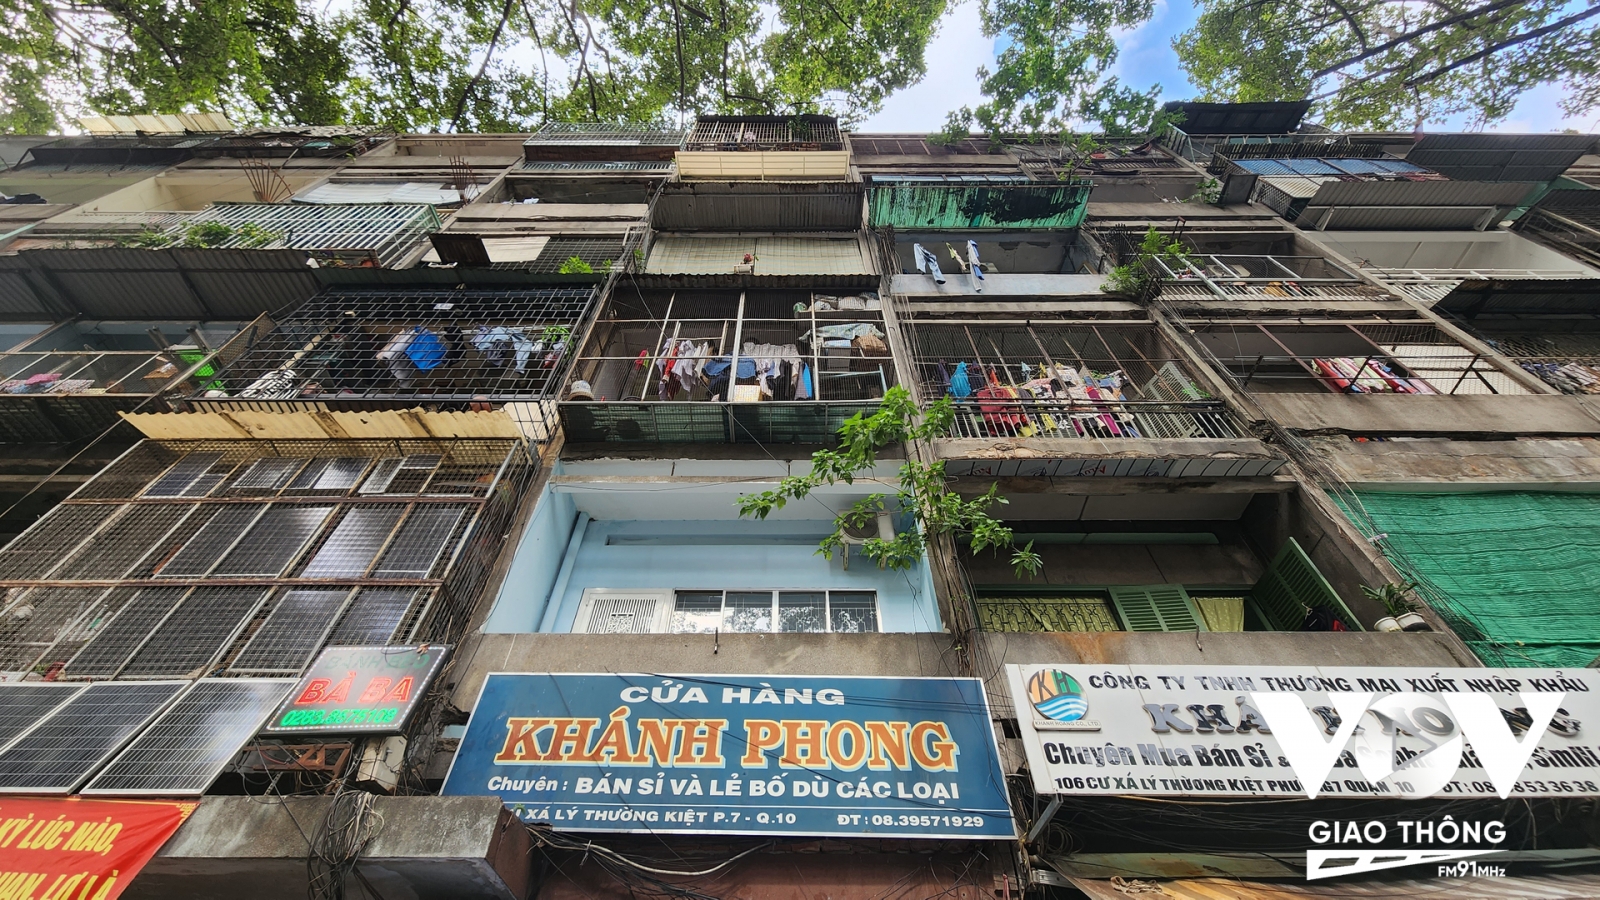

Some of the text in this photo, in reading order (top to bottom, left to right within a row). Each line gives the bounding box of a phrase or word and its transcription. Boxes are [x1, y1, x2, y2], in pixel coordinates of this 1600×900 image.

[358, 676, 414, 703] BA
[620, 680, 845, 706] CỬA HÀNG
[1089, 670, 1589, 696] CÔNG TY TNHH THƯƠNG MẠI XUẤT NHẬP KHẨU
[494, 705, 960, 773] KHÁNH PHONG
[1043, 742, 1137, 767] Chuyên
[1137, 743, 1193, 767] Mua
[1191, 743, 1245, 768] Bán
[1243, 742, 1273, 768] Sỉ
[488, 776, 558, 794] Chuyên
[575, 773, 632, 796] BÁN
[637, 773, 664, 796] SỈ
[670, 774, 704, 796] VÀ
[709, 774, 742, 797] LẺ
[749, 772, 787, 797] BỐ
[792, 776, 829, 798] DÙ
[836, 777, 892, 799] CÁC
[897, 782, 960, 805] LOẠI
[1054, 777, 1085, 789] 106
[1086, 776, 1110, 789] CƯ
[1112, 772, 1139, 790] XÁ
[1140, 775, 1157, 790] LÝ
[1227, 776, 1264, 795] KIỆT
[1394, 781, 1416, 793] 10
[525, 806, 550, 820] XÁ
[555, 806, 578, 820] LÝ
[584, 807, 659, 822] THƯỜNG
[664, 809, 708, 826] KIỆT
[713, 812, 741, 823] P.7
[757, 813, 797, 824] Q.10
[871, 815, 984, 828] 08.39571929
[16, 814, 75, 850] LÚC
[61, 816, 123, 856] NÀO,
